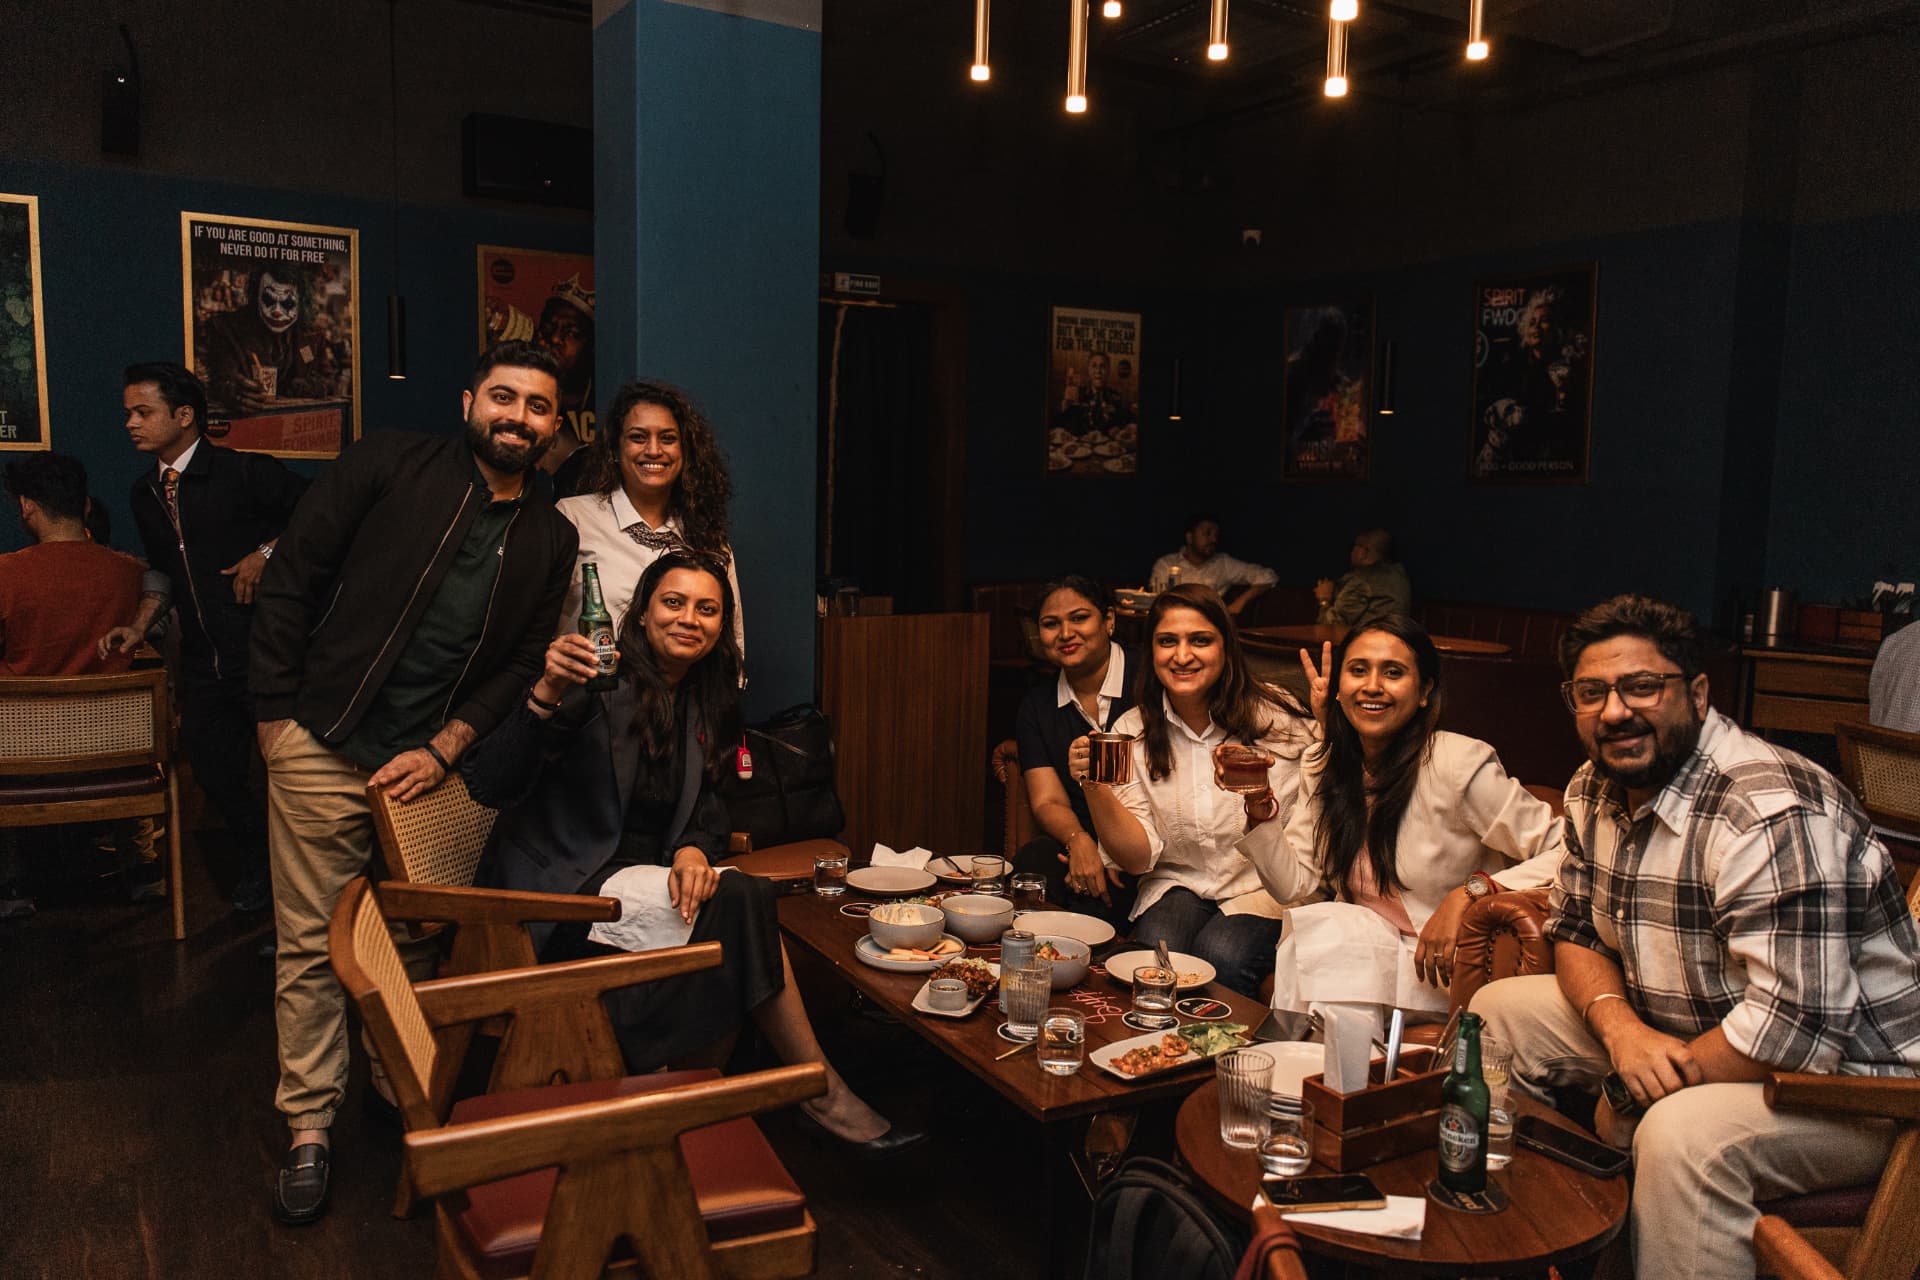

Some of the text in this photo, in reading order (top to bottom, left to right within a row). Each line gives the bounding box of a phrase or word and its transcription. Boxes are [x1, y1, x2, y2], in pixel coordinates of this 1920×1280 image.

[194, 225, 348, 253] IF YOU ARE GOOD AT SOMETHING,
[220, 242, 325, 263] NEVER DO IT FOR FREE
[1483, 288, 1526, 306] SPIRIT
[1056, 325, 1136, 340] BUT NOT THE CREAM
[1056, 336, 1135, 355] FOR THE STRUDEL
[293, 413, 336, 433] SPIRIT
[1508, 462, 1536, 472] GOOD
[1538, 461, 1575, 473] PERSON
